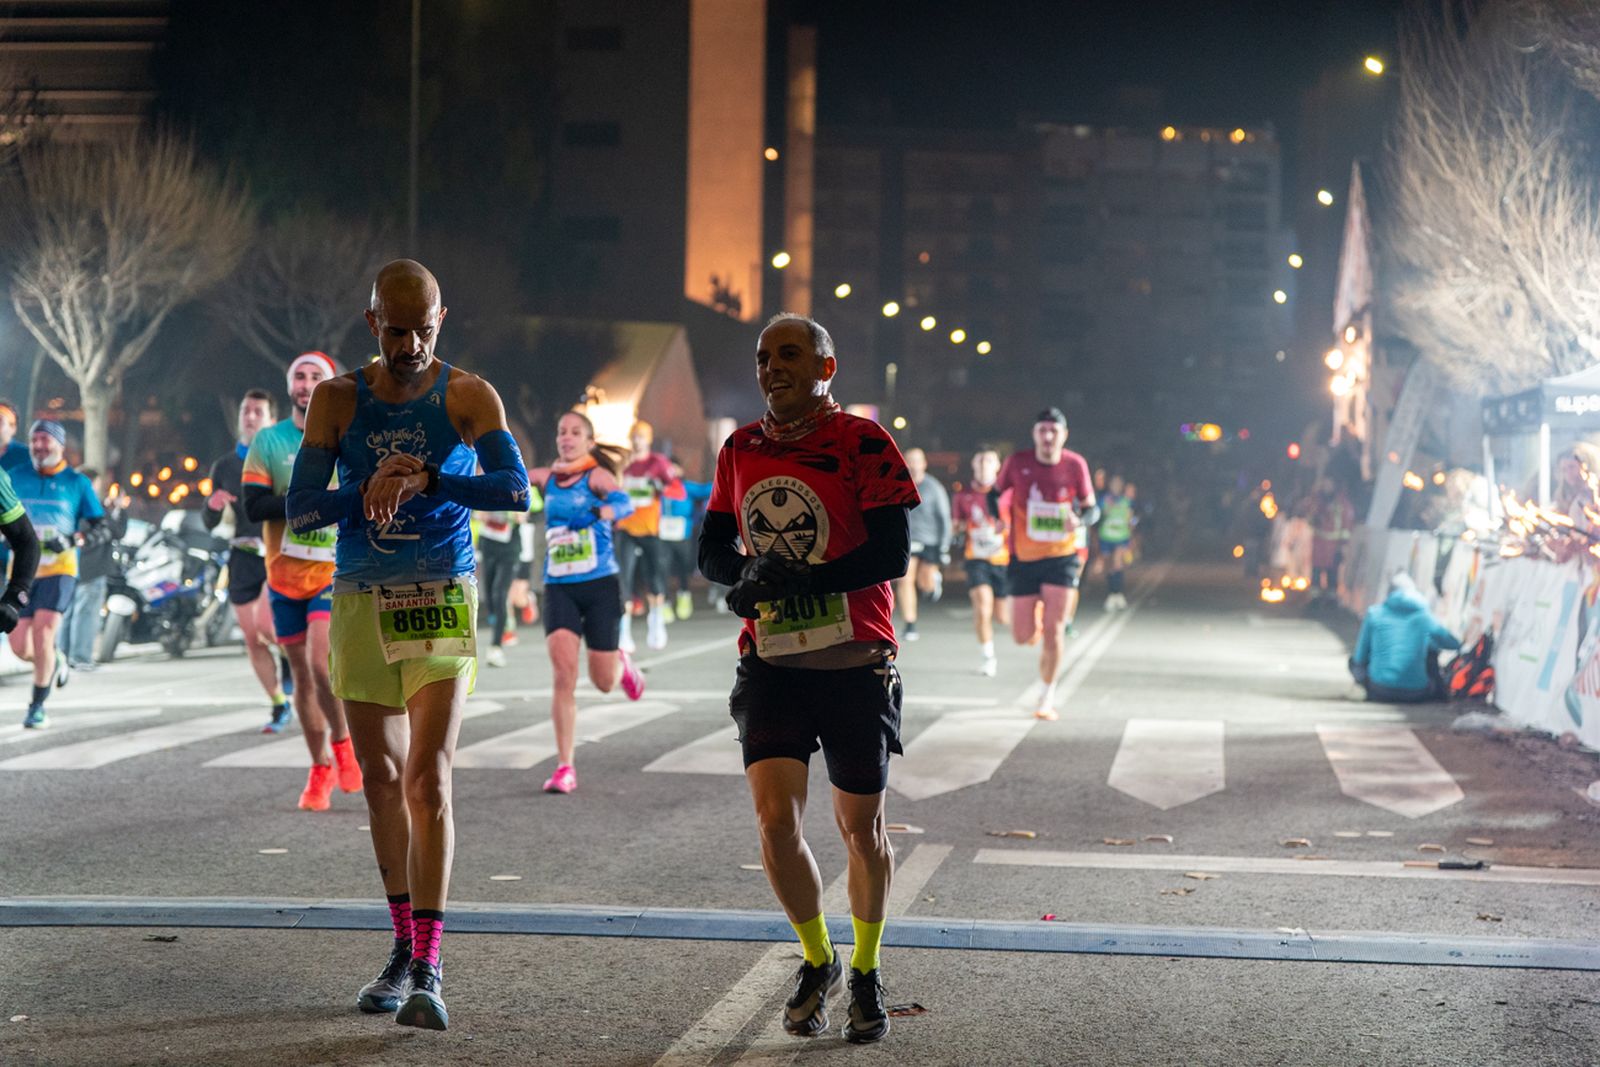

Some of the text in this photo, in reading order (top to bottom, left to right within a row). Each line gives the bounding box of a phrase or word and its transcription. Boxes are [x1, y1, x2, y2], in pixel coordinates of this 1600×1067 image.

[743, 479, 822, 511] LOS LEGAÑOSOS
[385, 601, 403, 610] SAN
[393, 606, 458, 633] 8699
